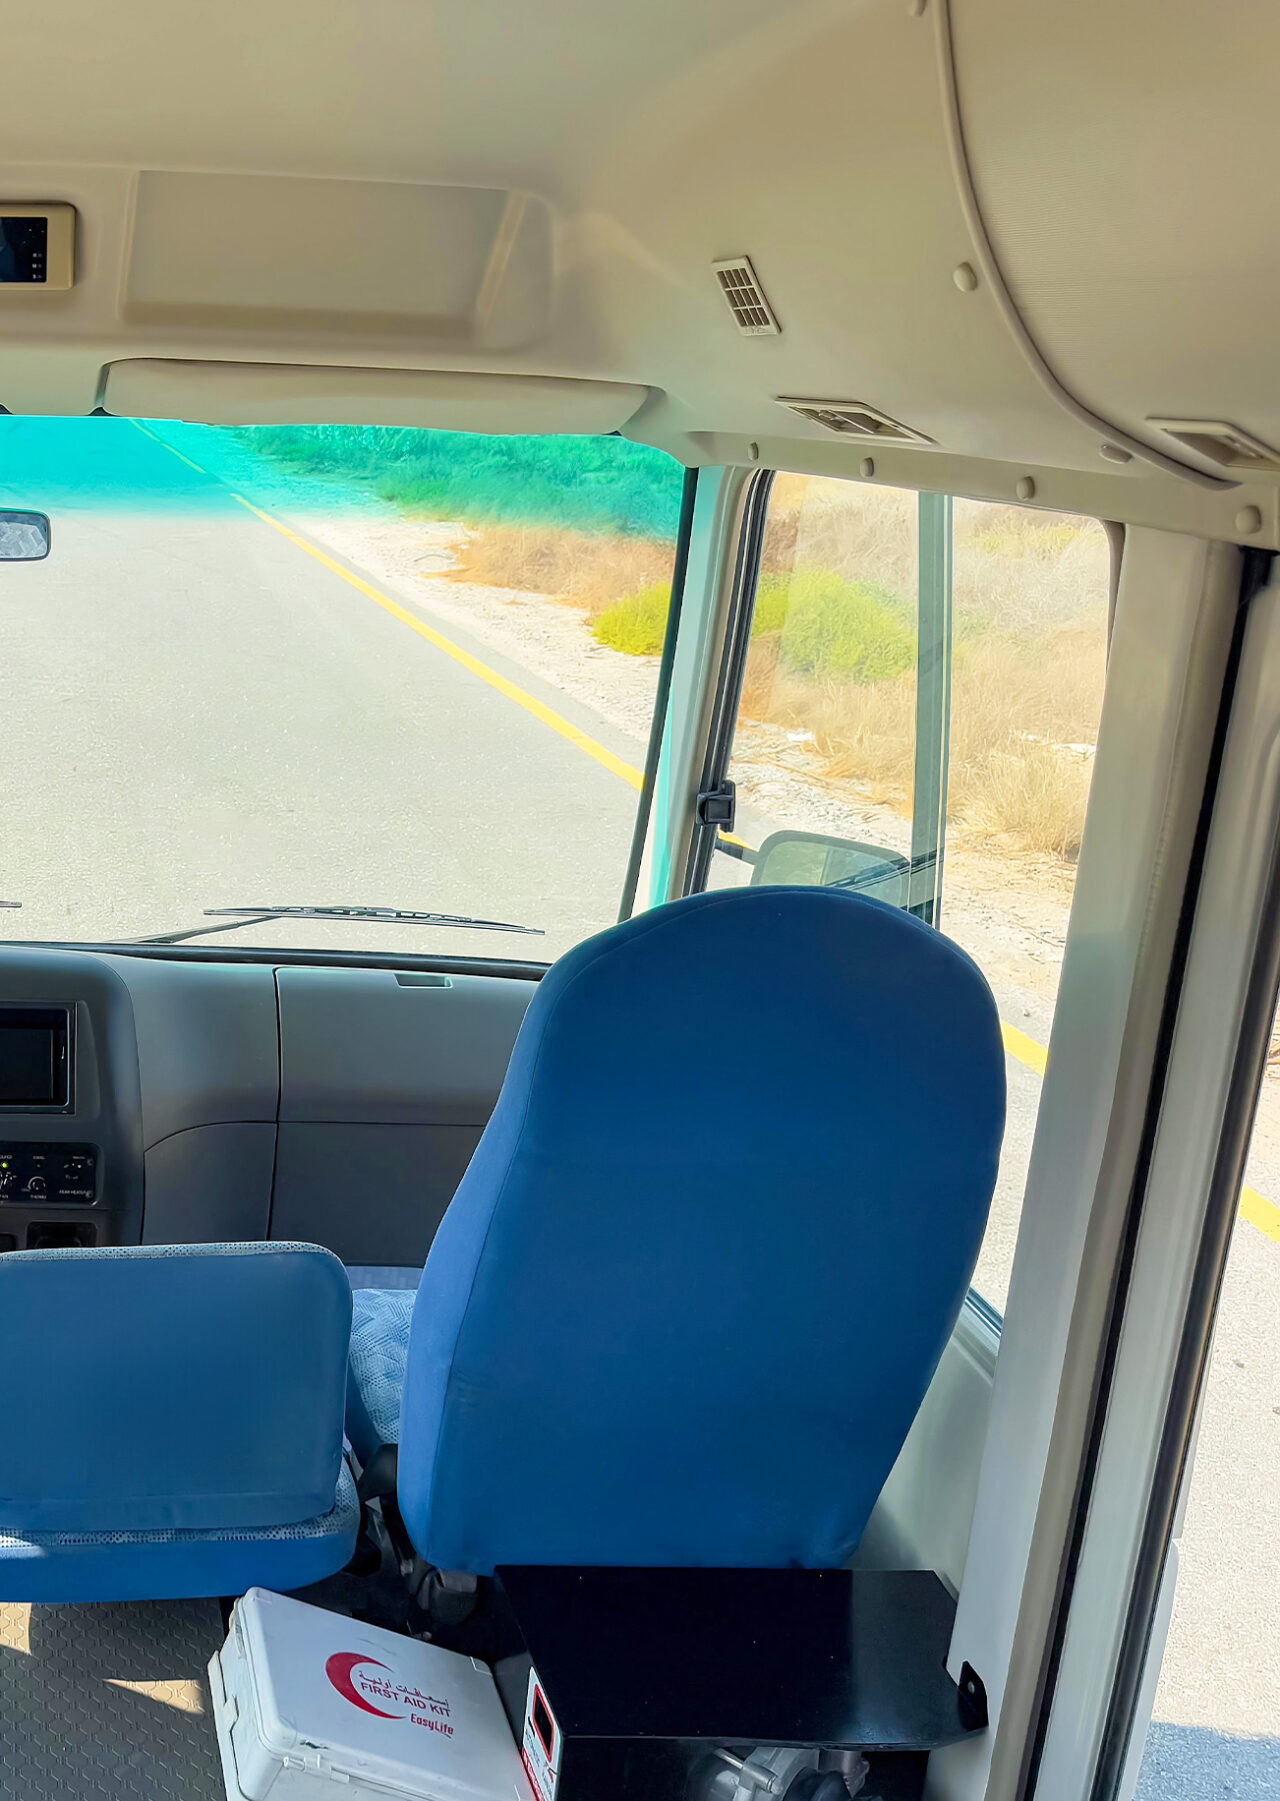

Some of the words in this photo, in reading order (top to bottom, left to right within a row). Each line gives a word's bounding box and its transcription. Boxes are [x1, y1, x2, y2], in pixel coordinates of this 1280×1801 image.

[361, 1682, 399, 1701] FIRST
[404, 1696, 426, 1710] AID
[430, 1703, 451, 1717] KIT
[410, 1713, 454, 1735] EasyLife
